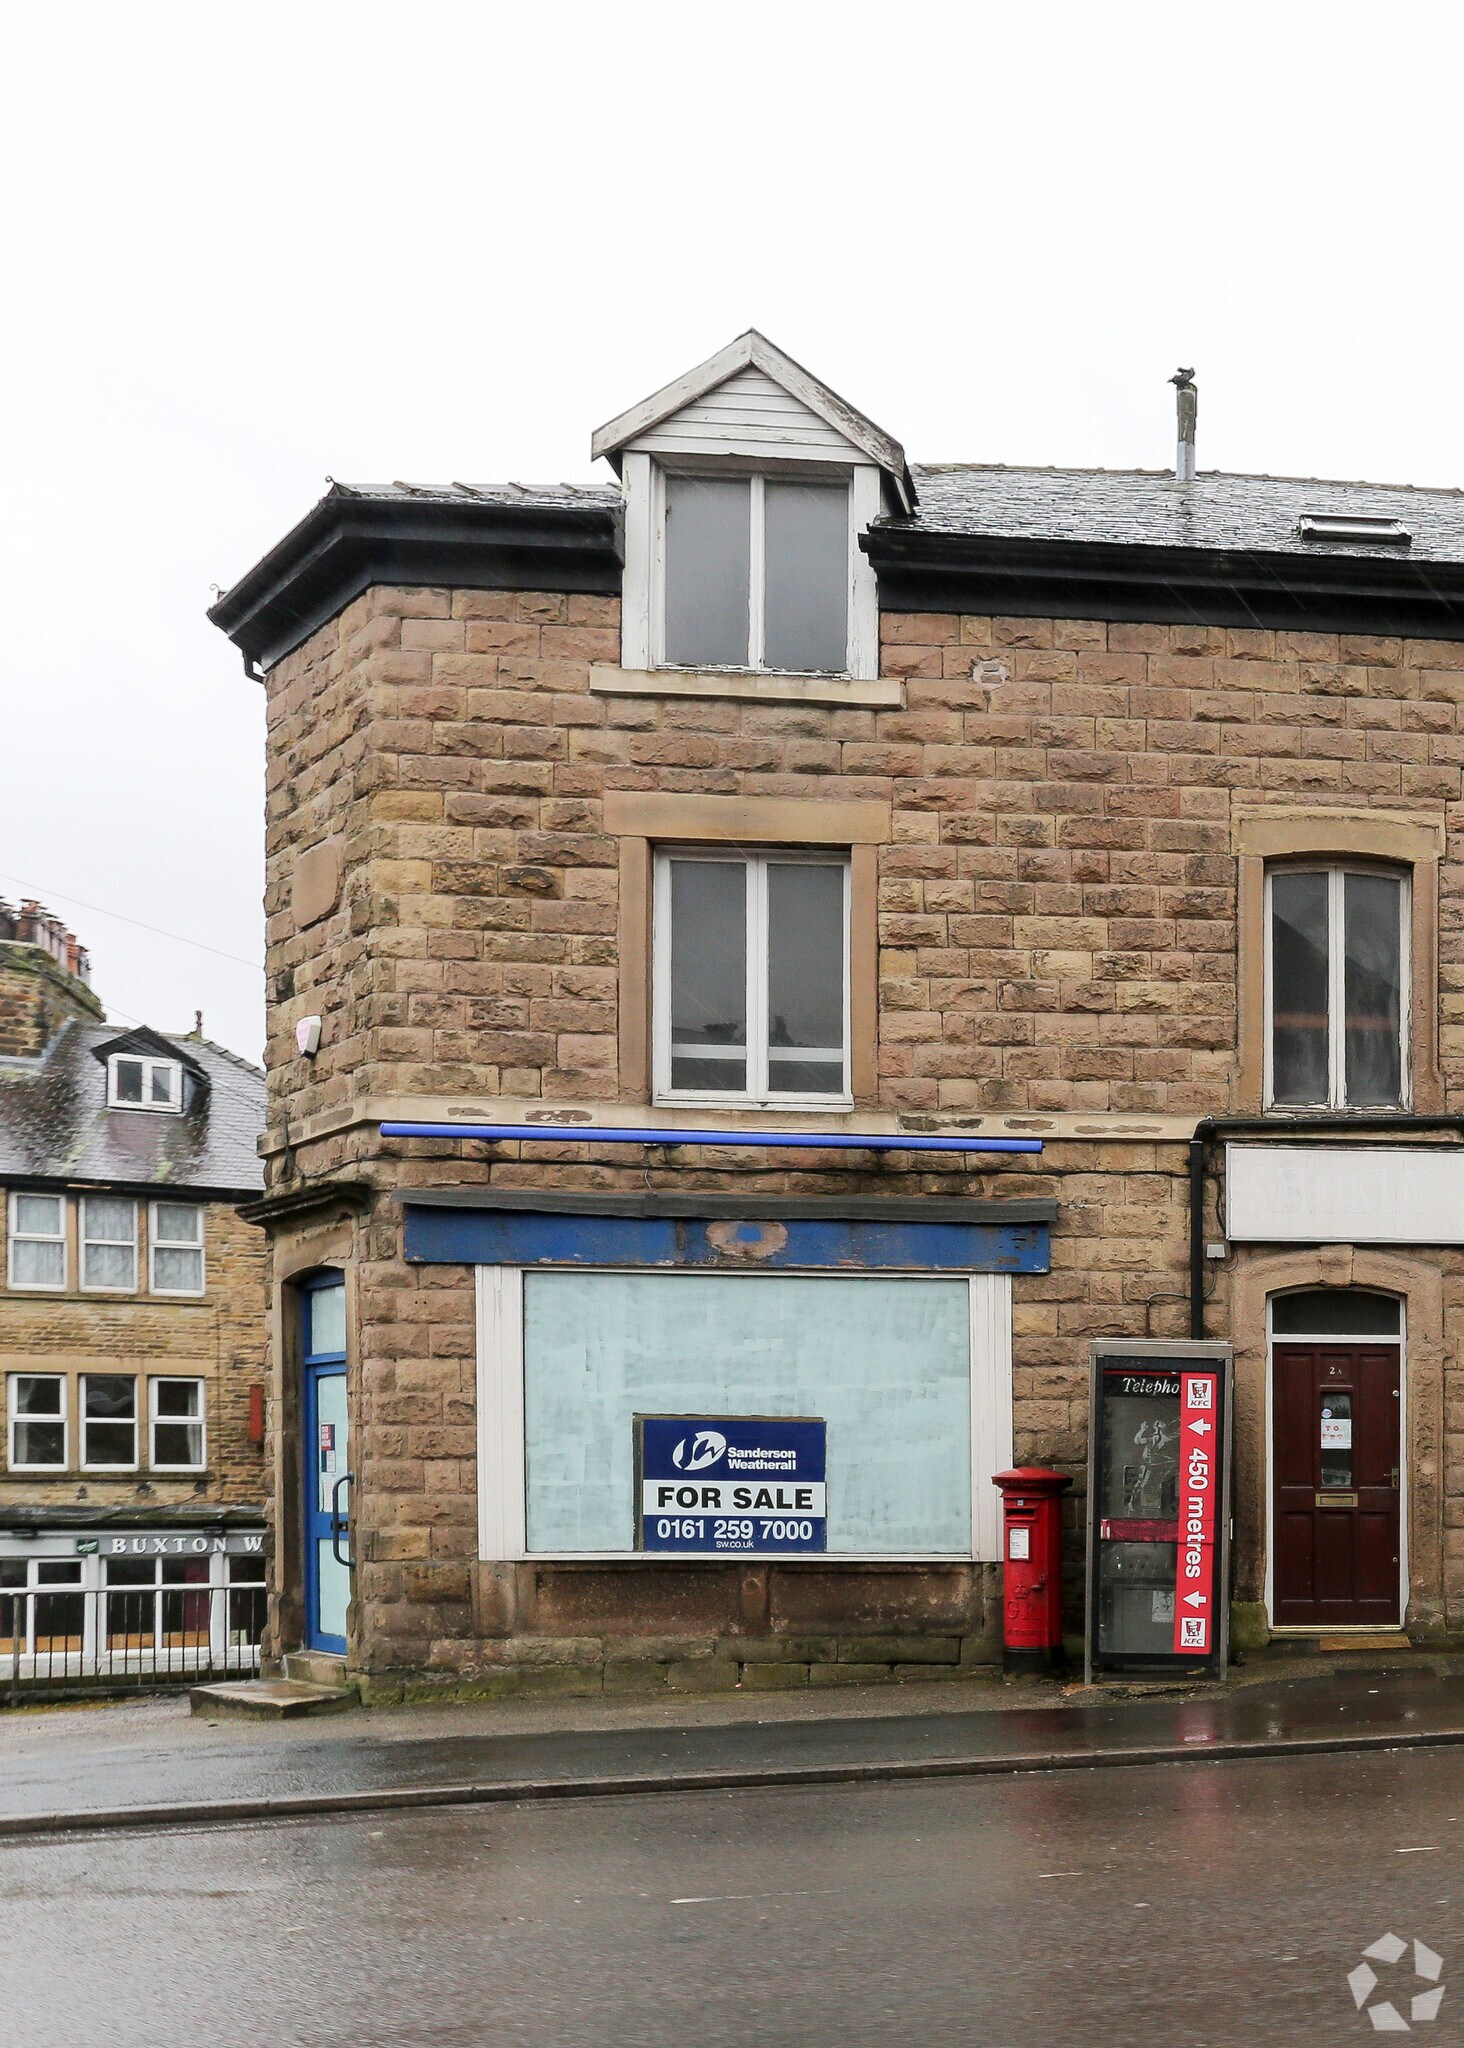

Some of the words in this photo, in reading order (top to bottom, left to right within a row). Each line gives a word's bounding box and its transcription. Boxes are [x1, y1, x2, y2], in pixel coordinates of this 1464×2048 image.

[1122, 1377, 1180, 1396] Telepho
[727, 1447, 796, 1459] Sanderson
[728, 1459, 796, 1470] Weatherall
[1188, 1447, 1208, 1490] 450
[657, 1487, 721, 1509] FOR
[733, 1488, 813, 1510] SALE
[657, 1519, 704, 1539] 0161
[714, 1519, 753, 1539] 259
[760, 1520, 812, 1540] 7000
[1185, 1496, 1206, 1578] metres
[111, 1537, 228, 1554] BUXTON
[716, 1540, 754, 1549] sw.co.uk
